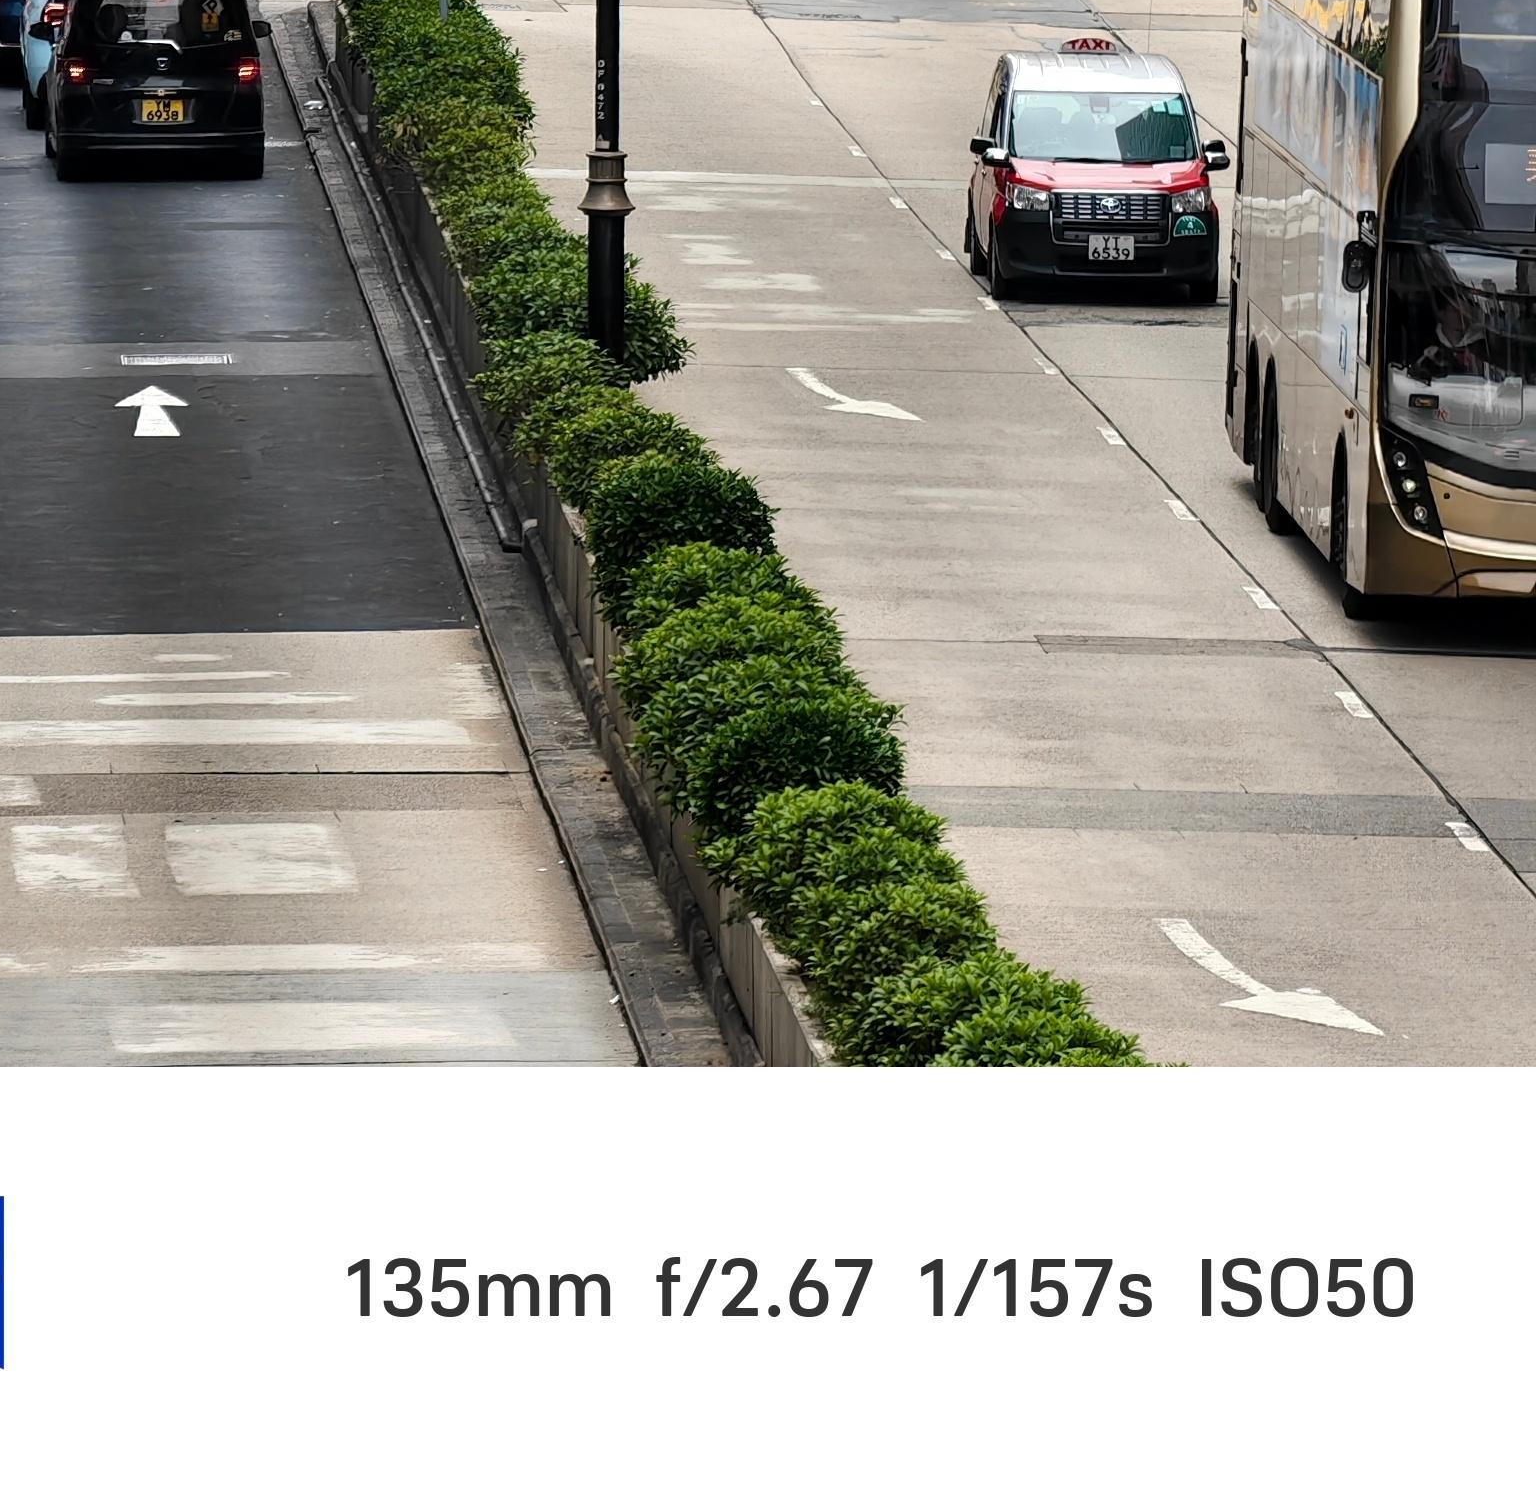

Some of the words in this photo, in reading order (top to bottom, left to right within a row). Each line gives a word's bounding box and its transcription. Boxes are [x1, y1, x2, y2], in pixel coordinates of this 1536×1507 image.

[1071, 39, 1110, 50] TAXI
[147, 110, 179, 121] 6938
[1091, 247, 1130, 260] 6539
